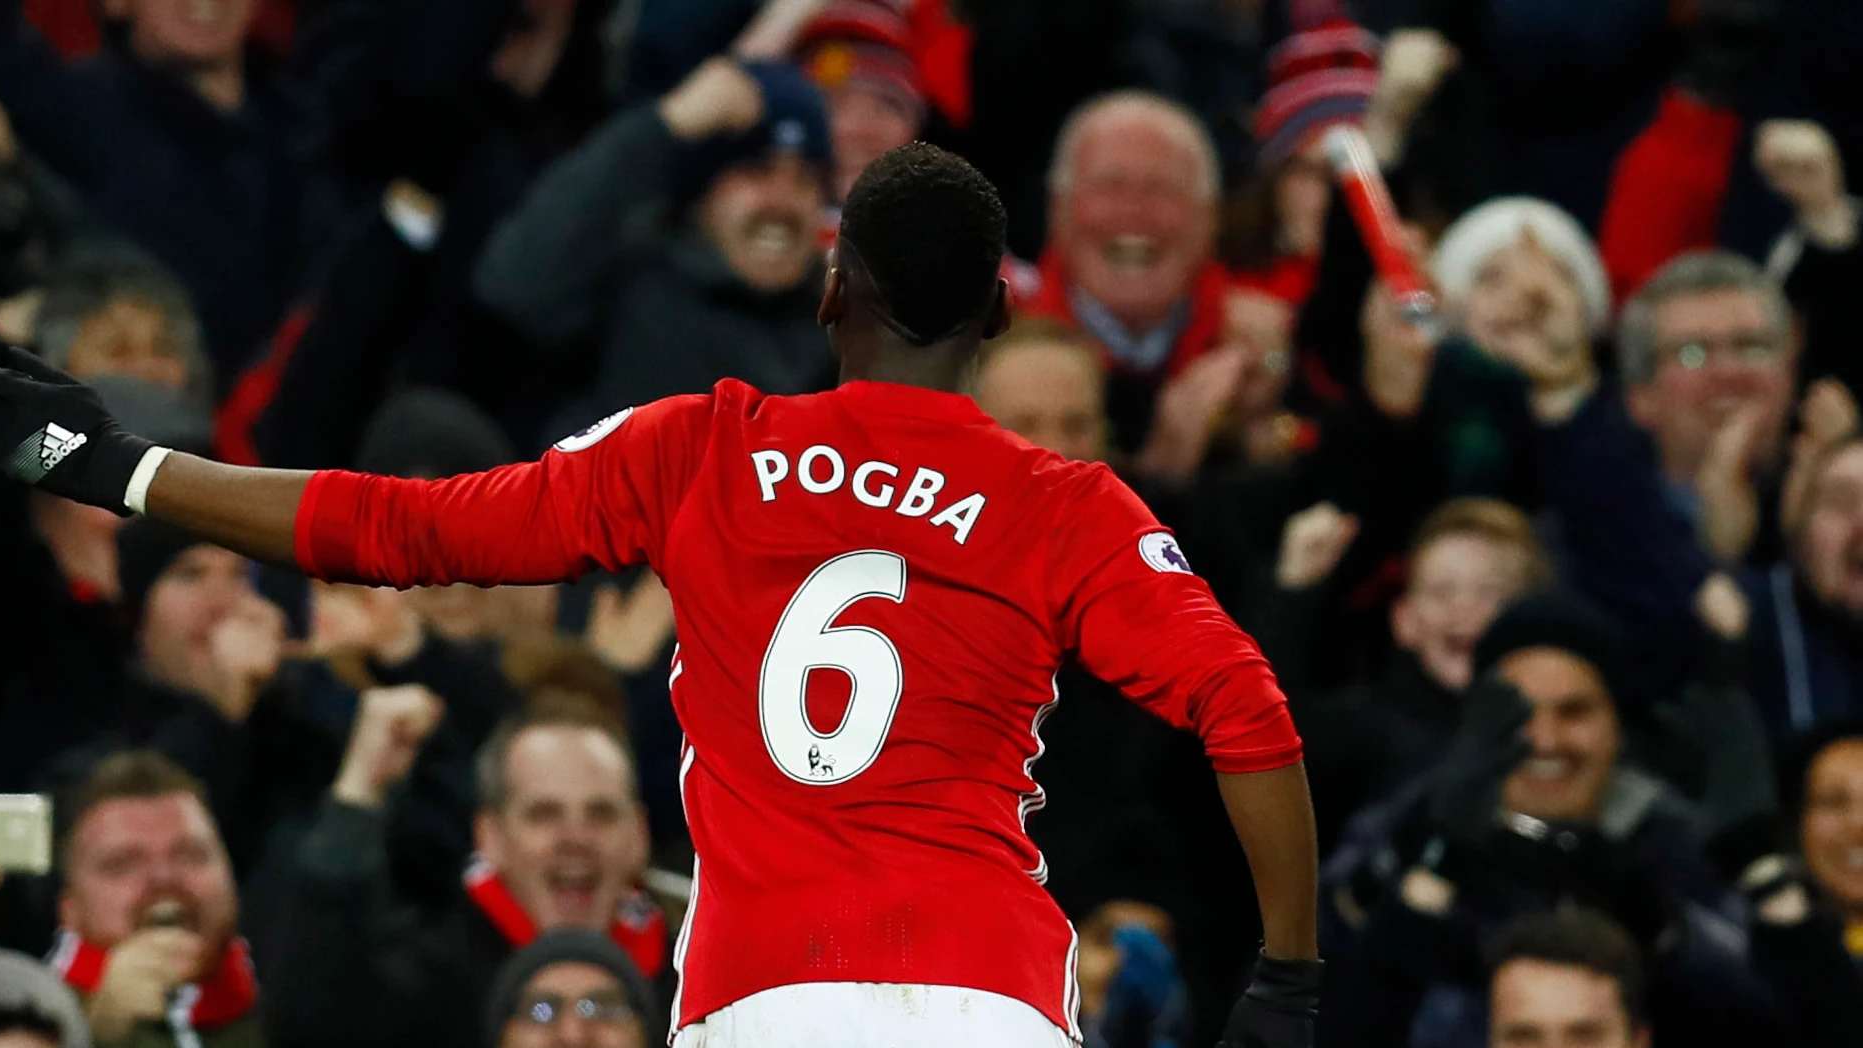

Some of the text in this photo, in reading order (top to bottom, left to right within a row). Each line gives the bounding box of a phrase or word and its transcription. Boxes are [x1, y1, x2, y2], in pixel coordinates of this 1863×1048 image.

[43, 433, 87, 470] adidas
[750, 444, 986, 545] POGBA
[758, 548, 907, 786] 6
